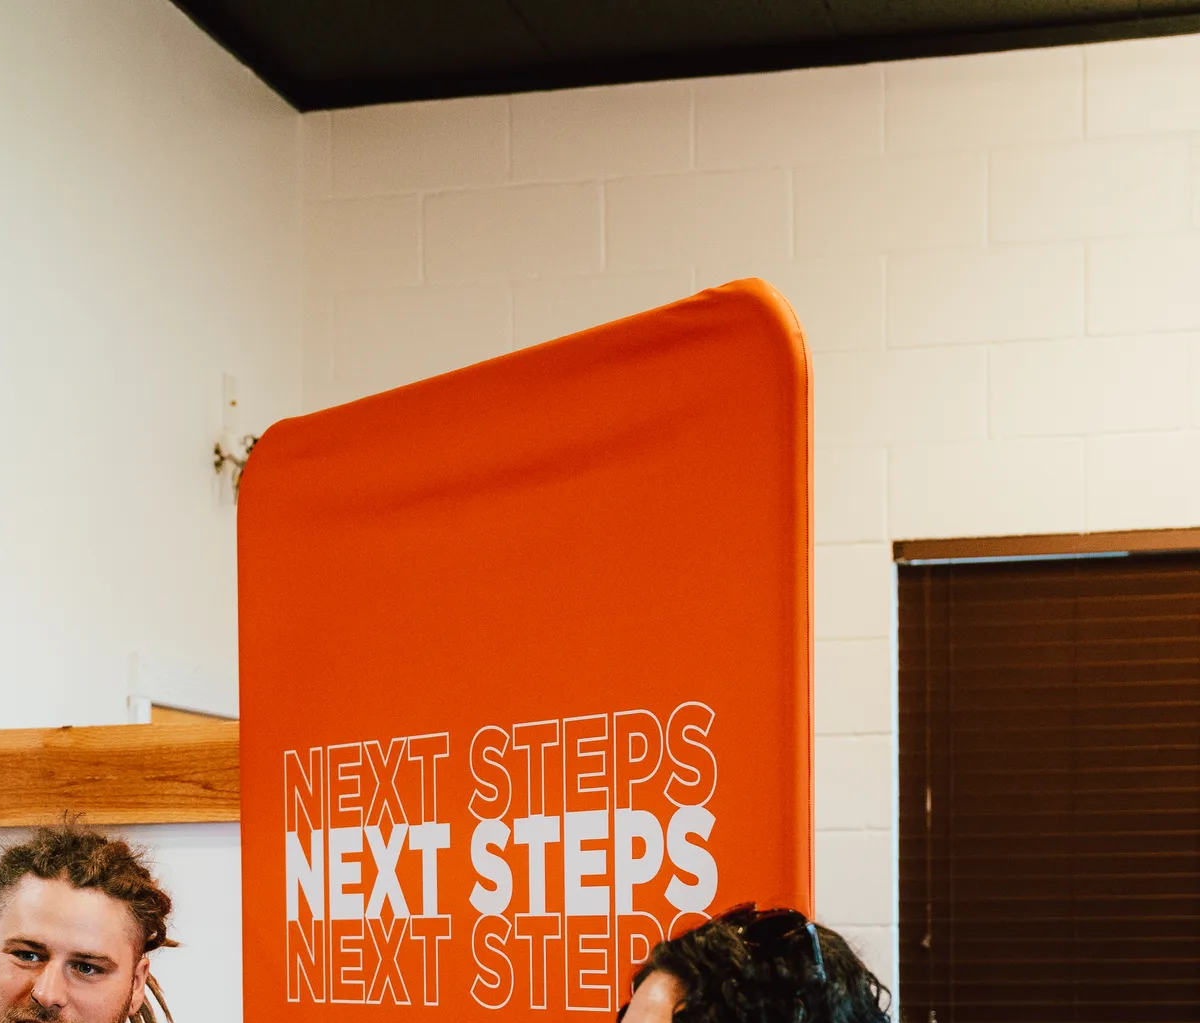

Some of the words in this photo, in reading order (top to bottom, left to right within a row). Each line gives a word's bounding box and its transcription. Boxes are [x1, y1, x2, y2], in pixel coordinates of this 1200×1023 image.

[284, 732, 450, 832] NEXT
[468, 701, 717, 822] STEPS
[286, 822, 451, 921] NEXT
[469, 805, 719, 915] STEPS
[286, 914, 452, 1006] NEXT
[470, 911, 713, 1011] STEP
